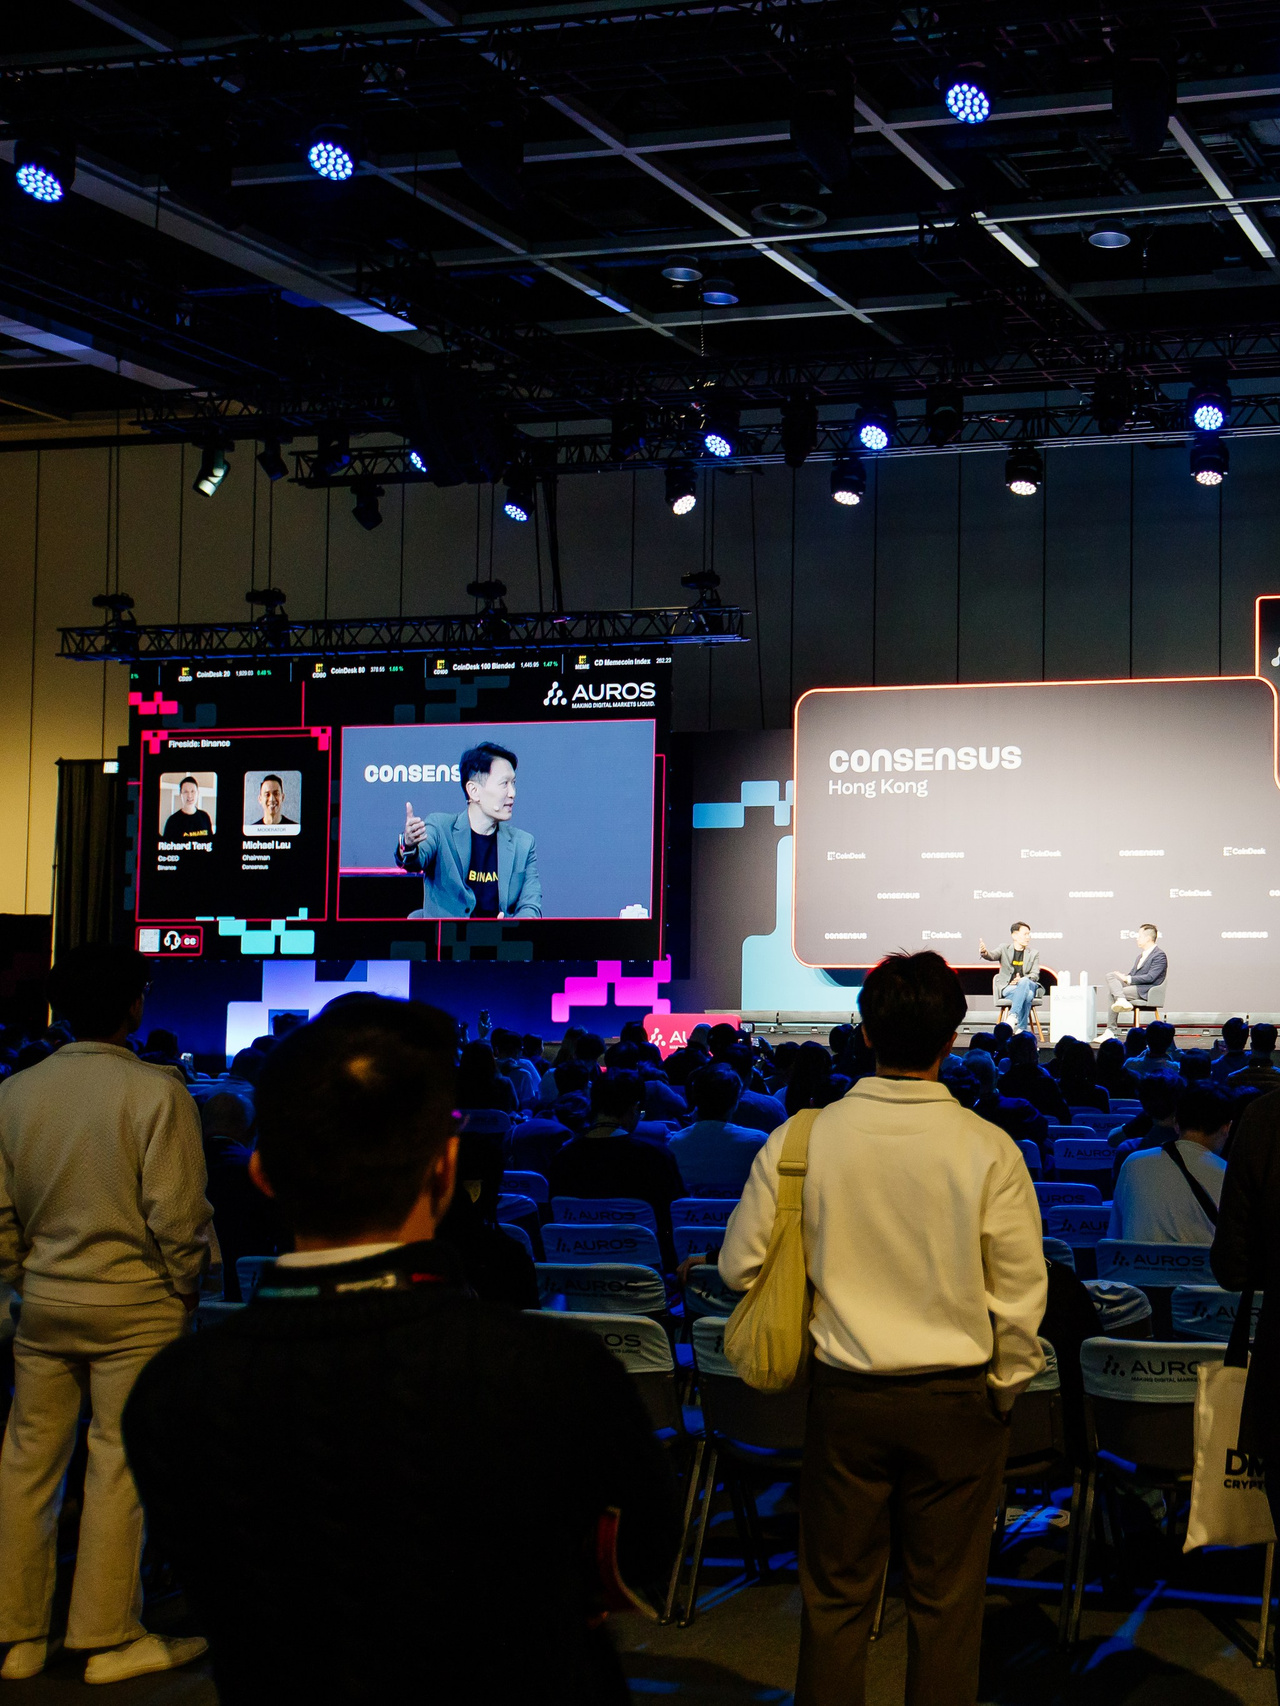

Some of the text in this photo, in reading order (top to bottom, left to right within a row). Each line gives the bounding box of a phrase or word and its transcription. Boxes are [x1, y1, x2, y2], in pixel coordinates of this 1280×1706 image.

[453, 663, 480, 671] CoinDesk
[481, 662, 491, 670] 100
[491, 661, 515, 669] Blended
[604, 658, 634, 666] Memecoin
[635, 657, 651, 665] Index
[331, 667, 357, 675] CoinDesk
[571, 682, 656, 701] AUROS
[168, 739, 231, 748] Fireside: Binance
[829, 745, 1022, 774] CONSENSUS
[364, 764, 461, 783] CONSENS
[828, 778, 928, 798] Hong Kong
[158, 841, 213, 853] Richard Teng
[242, 840, 292, 850] Michael Lau
[835, 851, 866, 860] CoinDesk
[921, 851, 965, 859] CONSENSUS
[1029, 849, 1062, 858] CoinDesk
[1119, 849, 1165, 857] CONSENSUS
[1232, 847, 1266, 855] CoinDesk
[242, 854, 271, 862] Chairman
[469, 870, 498, 883] BINAN
[877, 892, 920, 900] CONSENSUS
[982, 890, 1014, 899] CoinDesk
[1069, 890, 1114, 898] CONSENSUS
[1179, 889, 1212, 898] CoinDesk
[824, 932, 868, 940] CONSENSUS
[930, 930, 962, 939] CoinDesk
[1221, 931, 1268, 939] CONSENSUS
[573, 1239, 638, 1251] AUROS
[1134, 1255, 1205, 1267] AUROS
